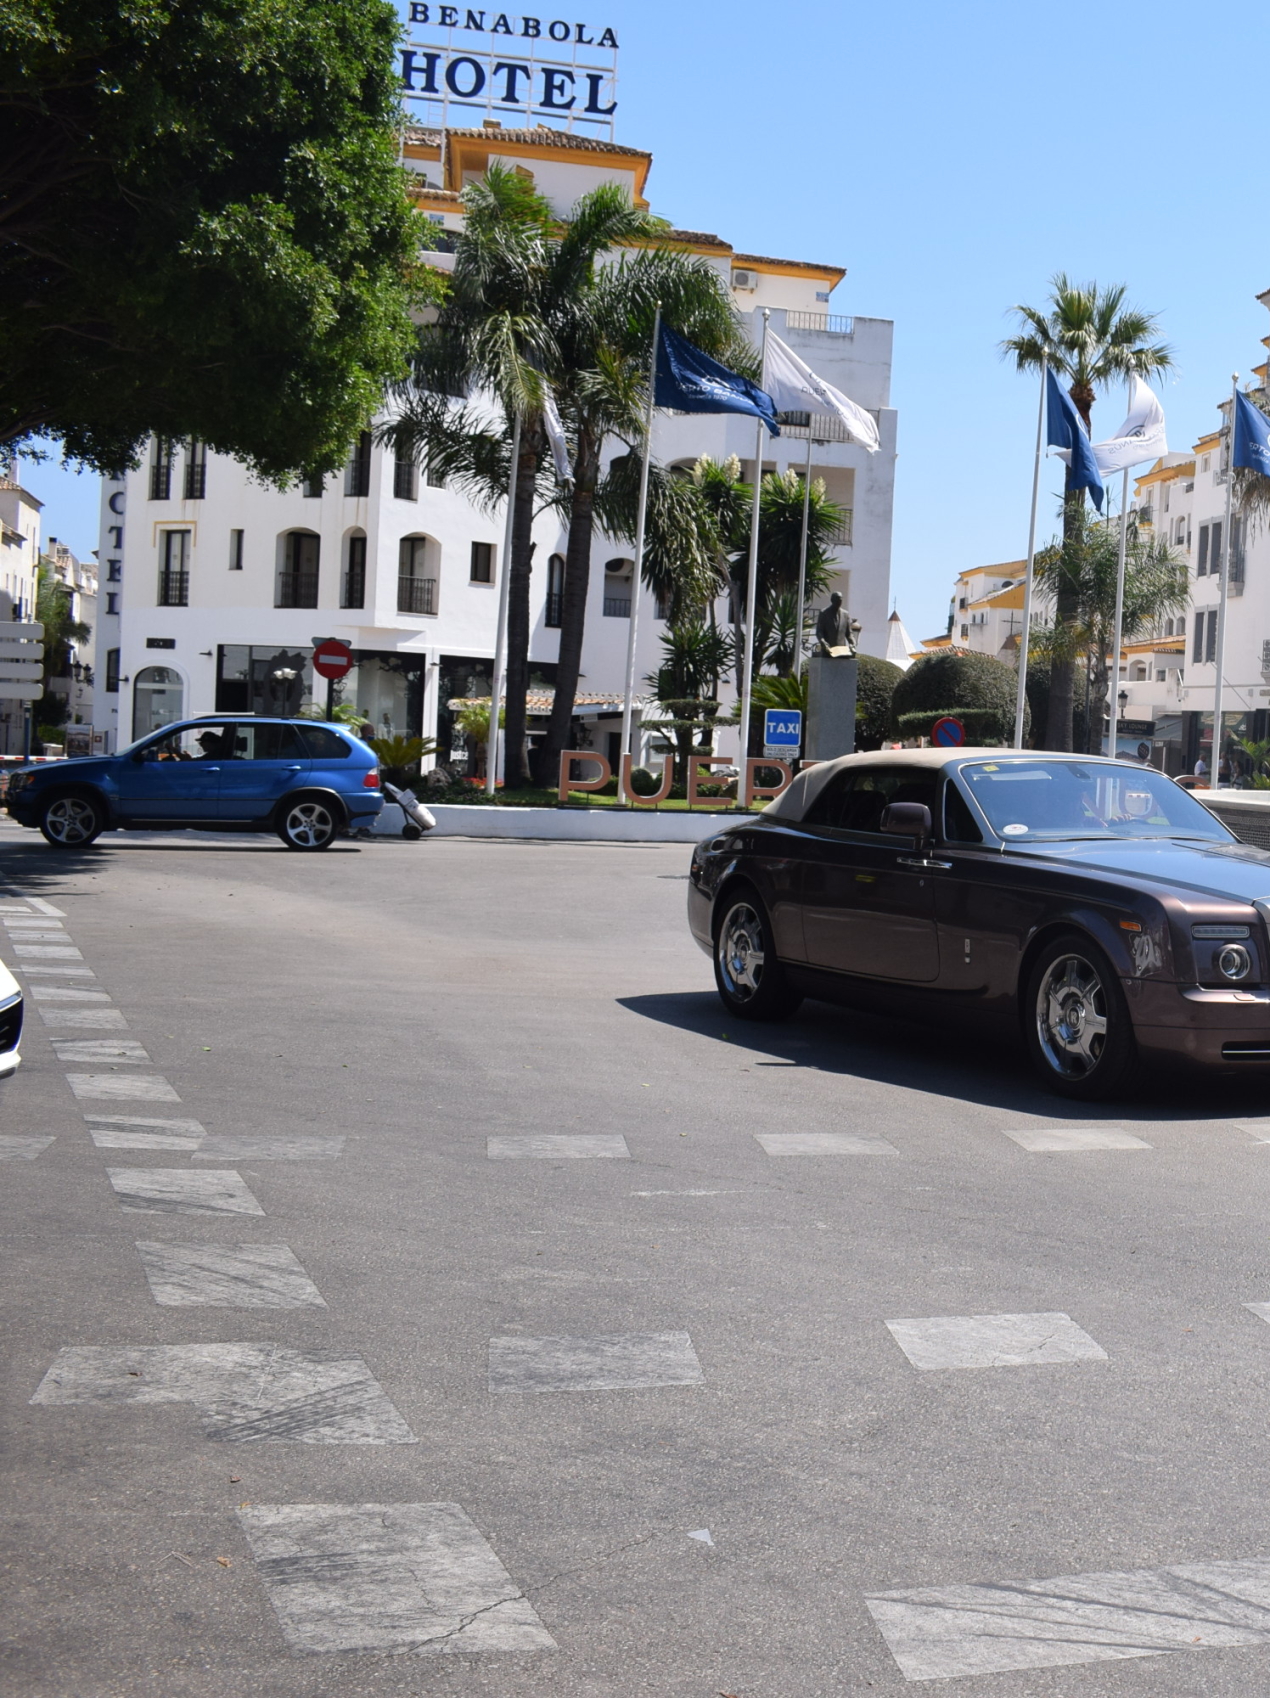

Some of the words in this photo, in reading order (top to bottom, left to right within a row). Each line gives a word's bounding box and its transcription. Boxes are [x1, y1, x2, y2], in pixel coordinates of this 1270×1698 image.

[409, 1, 619, 49] BENABOLA
[400, 50, 618, 115] HOTEL
[768, 722, 800, 734] TAXI
